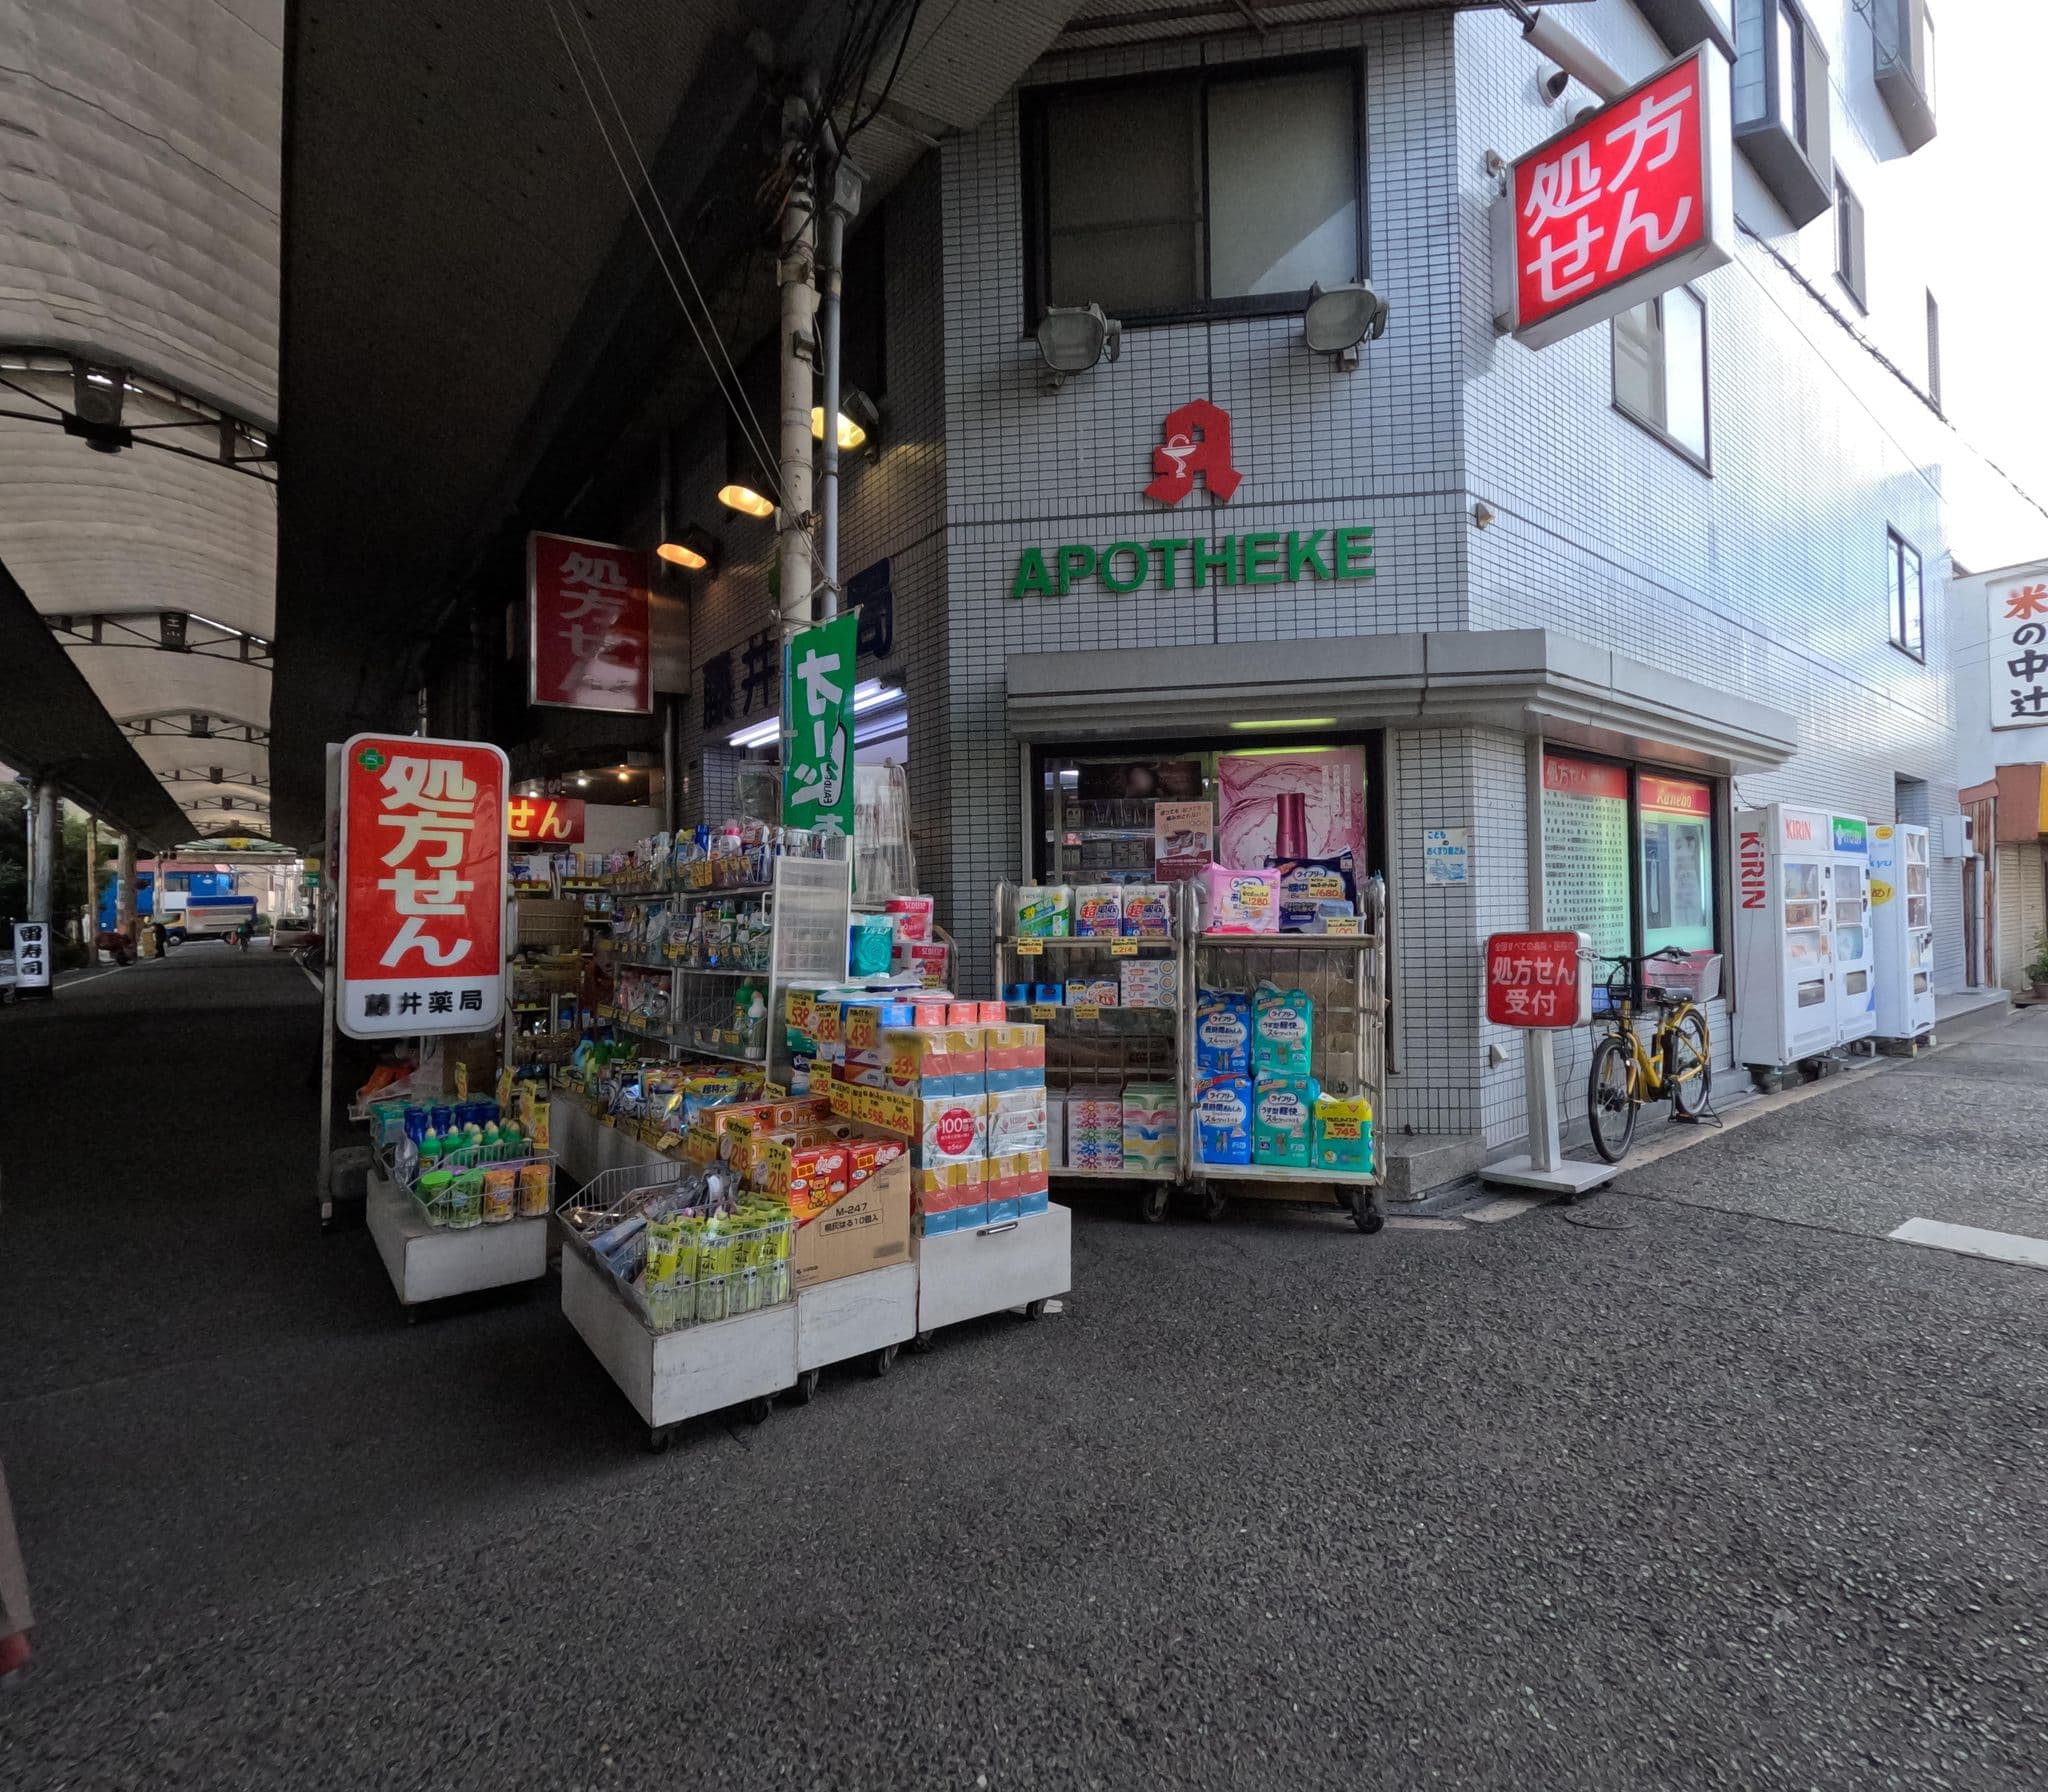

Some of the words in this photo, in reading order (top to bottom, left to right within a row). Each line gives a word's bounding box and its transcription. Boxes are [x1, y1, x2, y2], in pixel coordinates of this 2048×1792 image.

[1524, 85, 1692, 238] 処方
[1526, 187, 1692, 302] せん
[1012, 526, 1376, 599] APOTHEKE
[1785, 819, 1812, 841] KIRIN
[377, 755, 478, 968] 処方せん
[1492, 956, 1576, 986] 処方せん
[1505, 989, 1557, 1017] 受付
[835, 1202, 868, 1217] M-247
